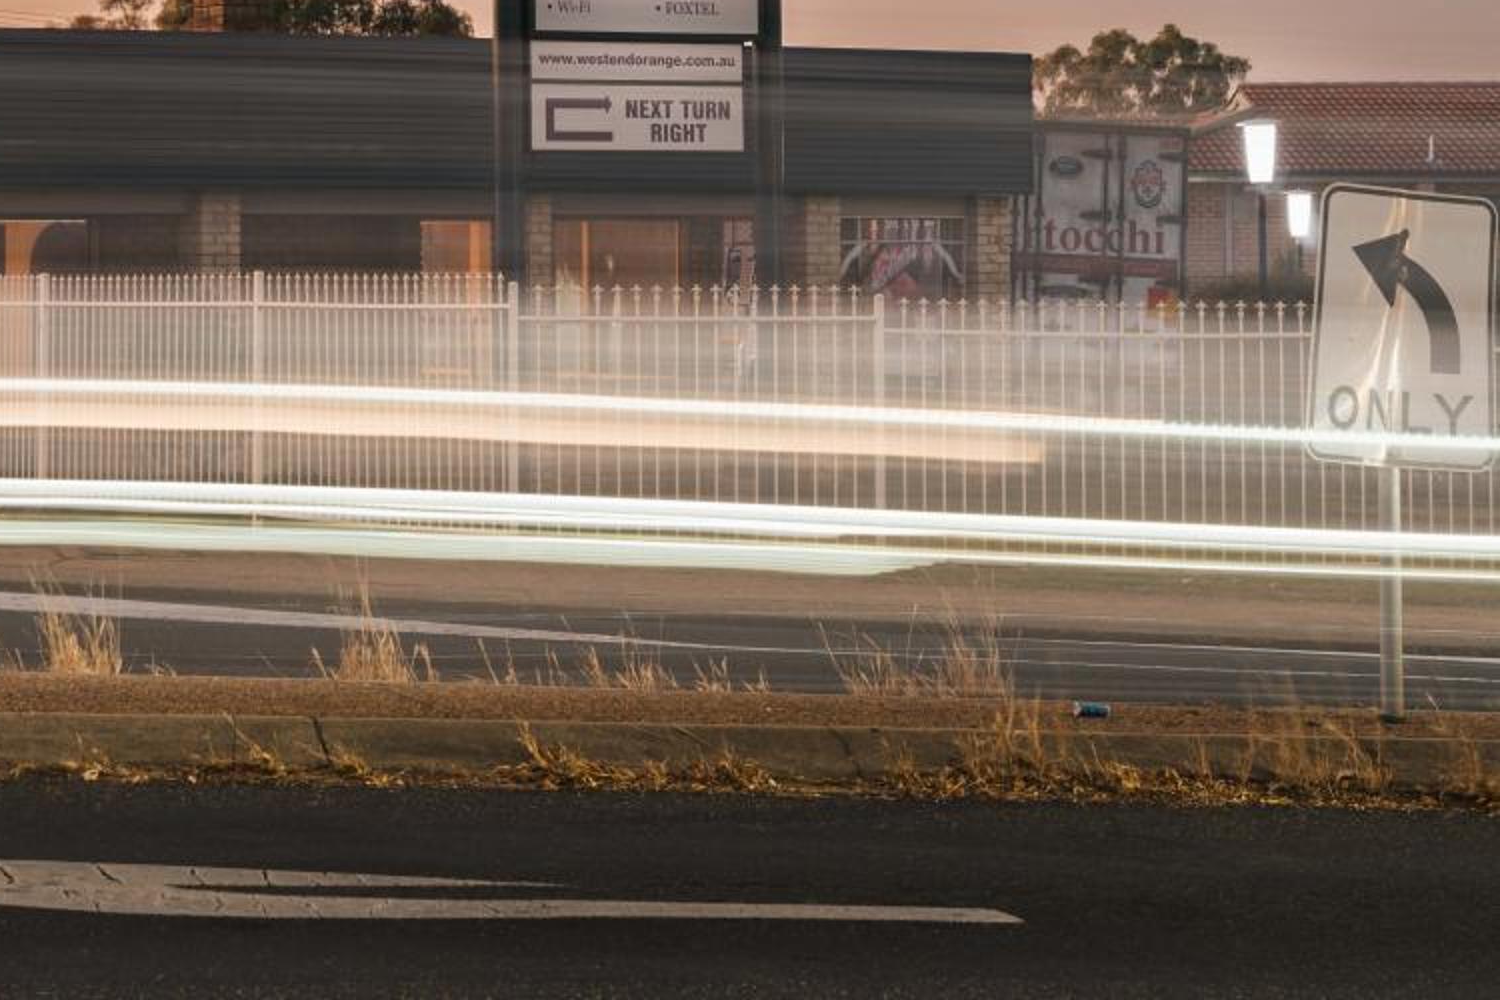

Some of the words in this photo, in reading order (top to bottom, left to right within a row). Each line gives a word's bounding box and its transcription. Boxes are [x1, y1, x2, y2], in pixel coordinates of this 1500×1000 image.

[665, 2, 720, 16] FOXTEL
[538, 54, 736, 69] www.westendorange.com.au
[625, 100, 674, 120] NEXT
[682, 101, 731, 121] TURN
[650, 123, 708, 143] RIGHT
[1328, 385, 1474, 437] ONLY
